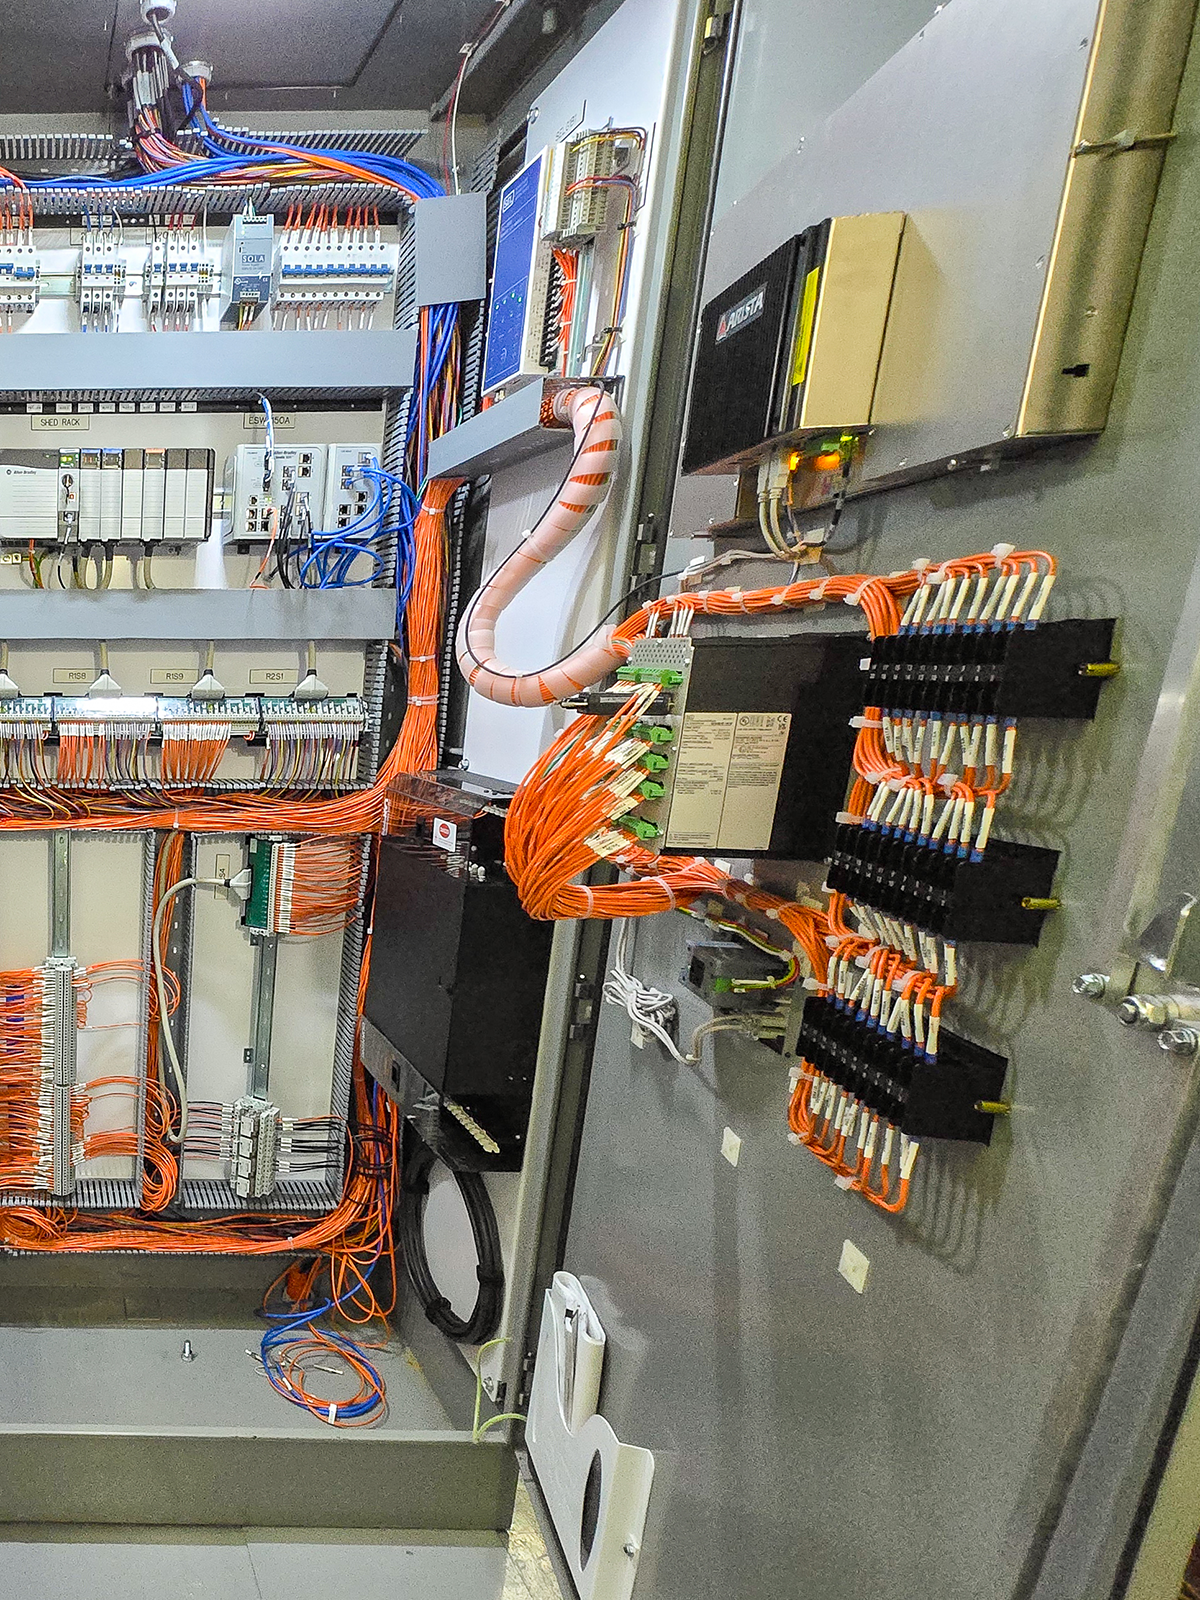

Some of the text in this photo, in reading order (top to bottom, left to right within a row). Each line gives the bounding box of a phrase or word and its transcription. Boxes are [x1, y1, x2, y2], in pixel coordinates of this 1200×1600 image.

[725, 291, 764, 332] ARISTA
[40, 418, 80, 426] SHED RACK
[68, 672, 87, 680] R1S8
[166, 672, 184, 680] R1S9
[265, 672, 284, 680] R2S1
